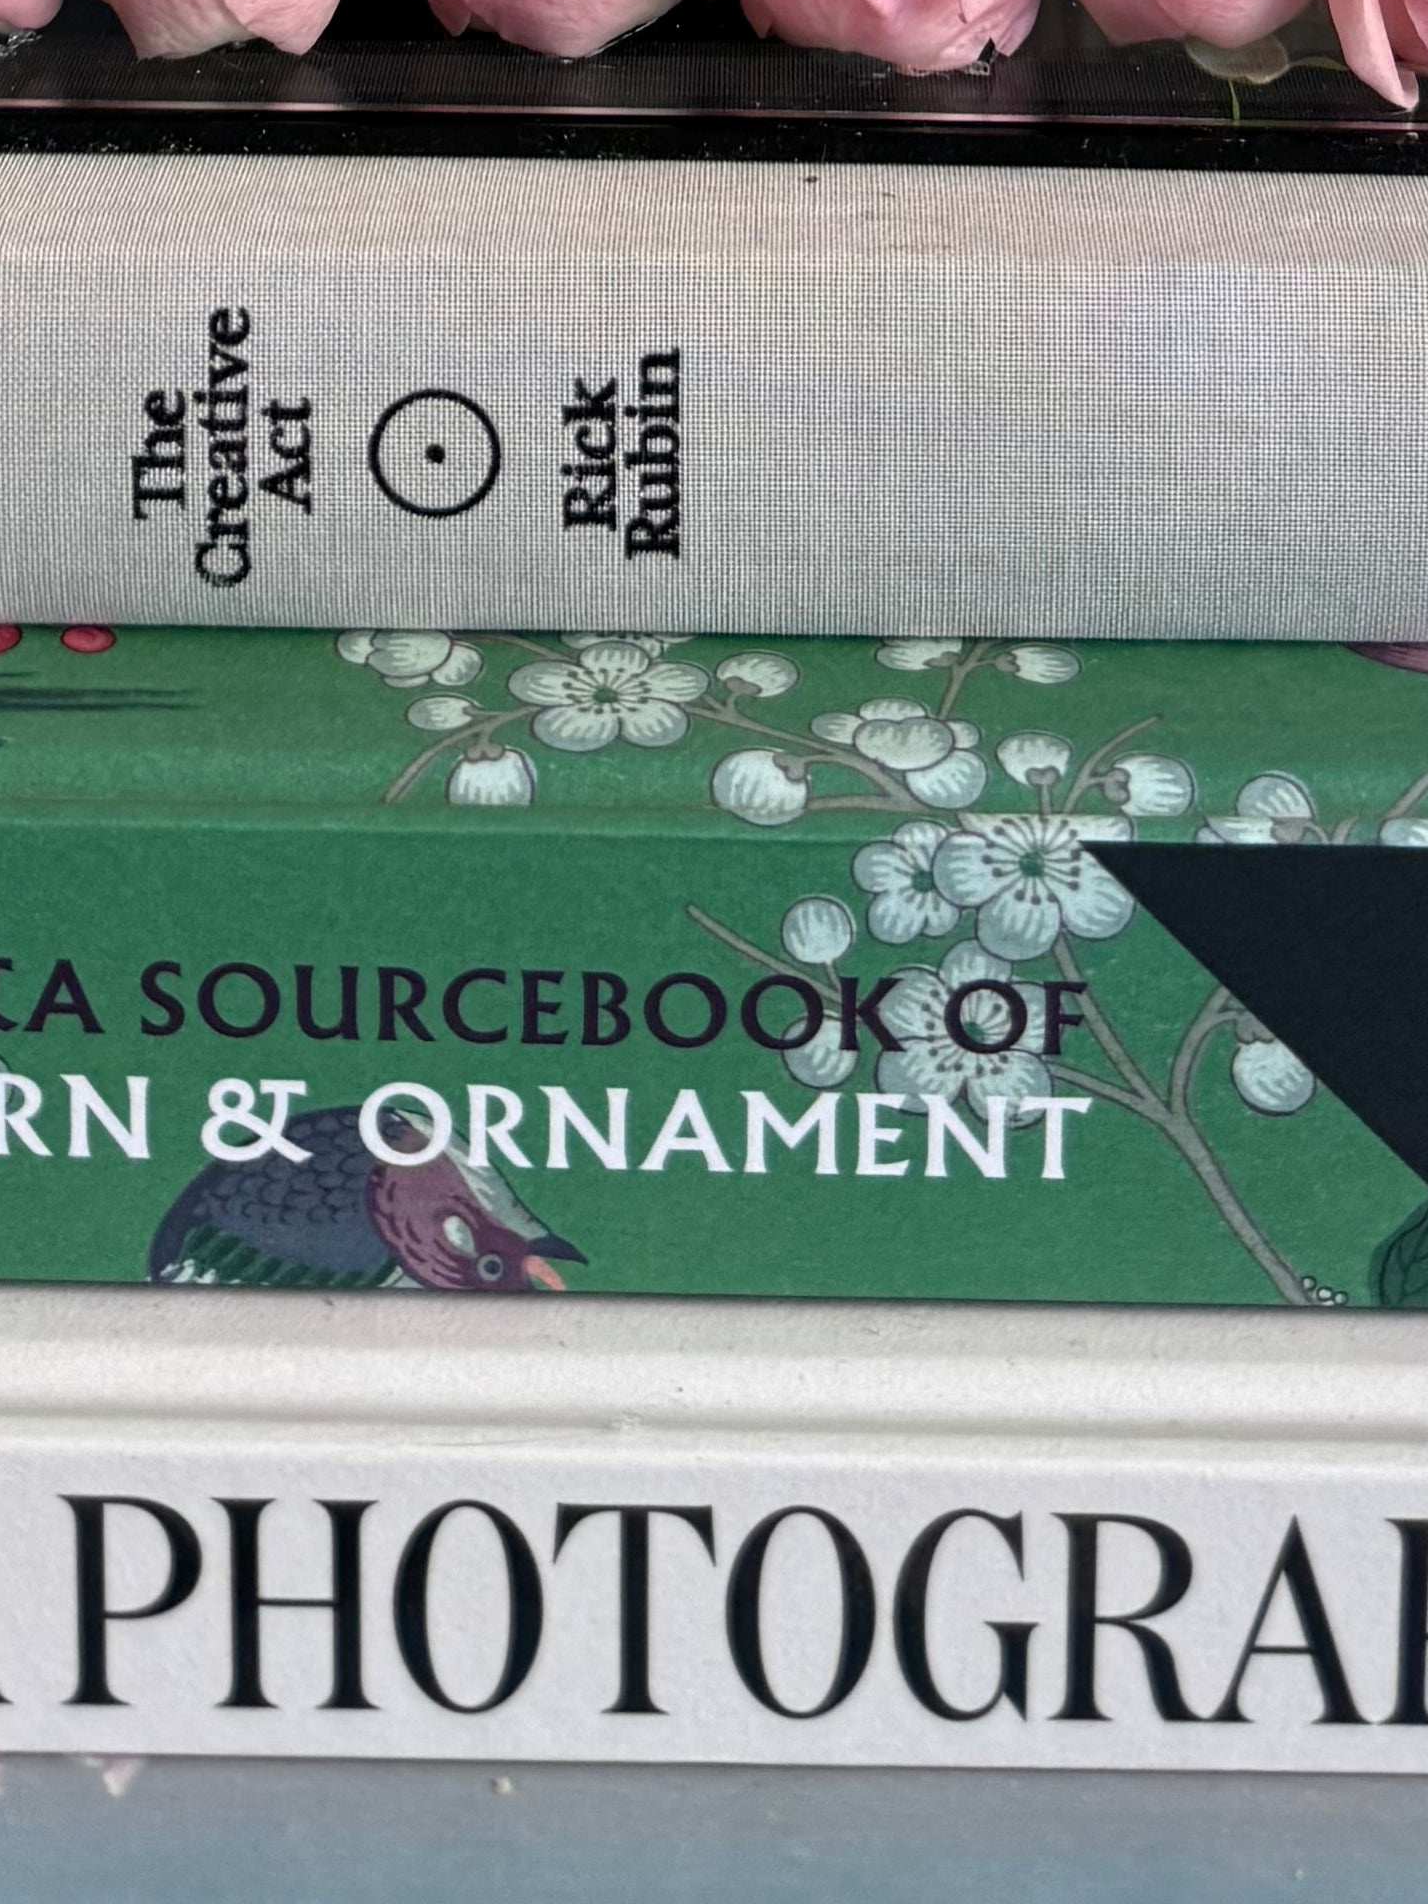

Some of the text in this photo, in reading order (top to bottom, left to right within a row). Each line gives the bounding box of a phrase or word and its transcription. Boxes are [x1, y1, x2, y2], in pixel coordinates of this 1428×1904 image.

[132, 390, 186, 520] The
[195, 305, 252, 587] Creative
[259, 396, 313, 515] Act
[560, 377, 619, 532] Rick
[624, 347, 681, 560] Rubin
[139, 960, 906, 1053] SOURCEBOOK
[943, 976, 1089, 1057] OF
[199, 1077, 315, 1163] &
[358, 1081, 1093, 1180] ORNAMENT
